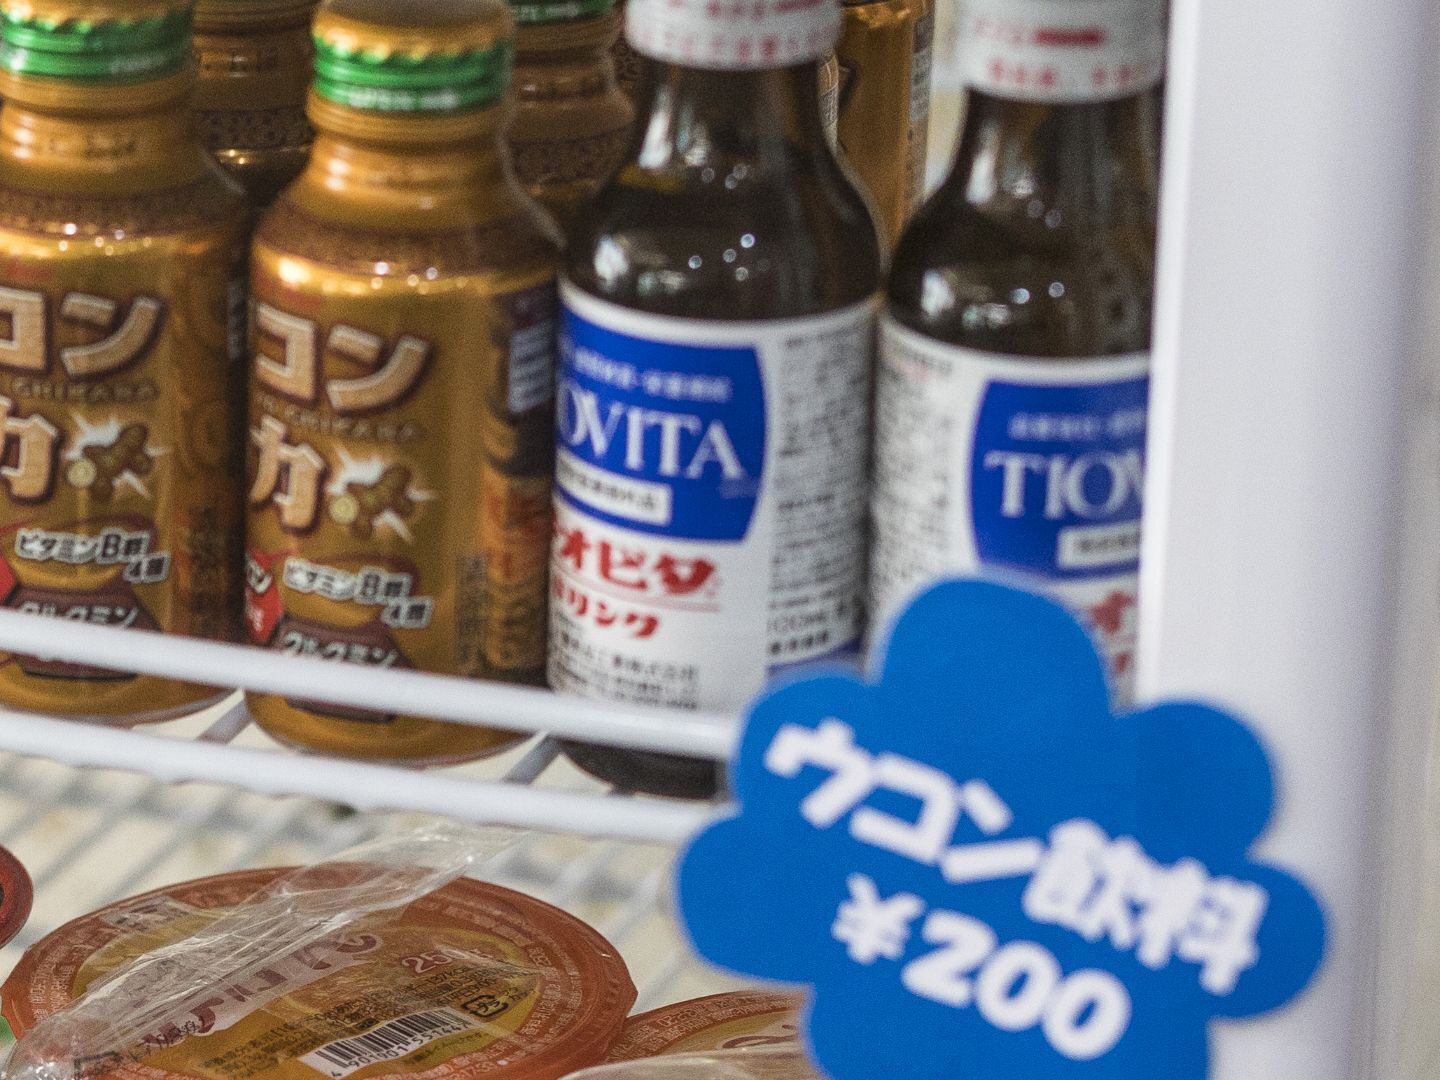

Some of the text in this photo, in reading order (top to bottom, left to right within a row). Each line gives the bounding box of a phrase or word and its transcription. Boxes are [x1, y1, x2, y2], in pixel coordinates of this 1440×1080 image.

[764, 718, 1268, 996] ウコン飲料
[831, 871, 1133, 1061] ¥200
